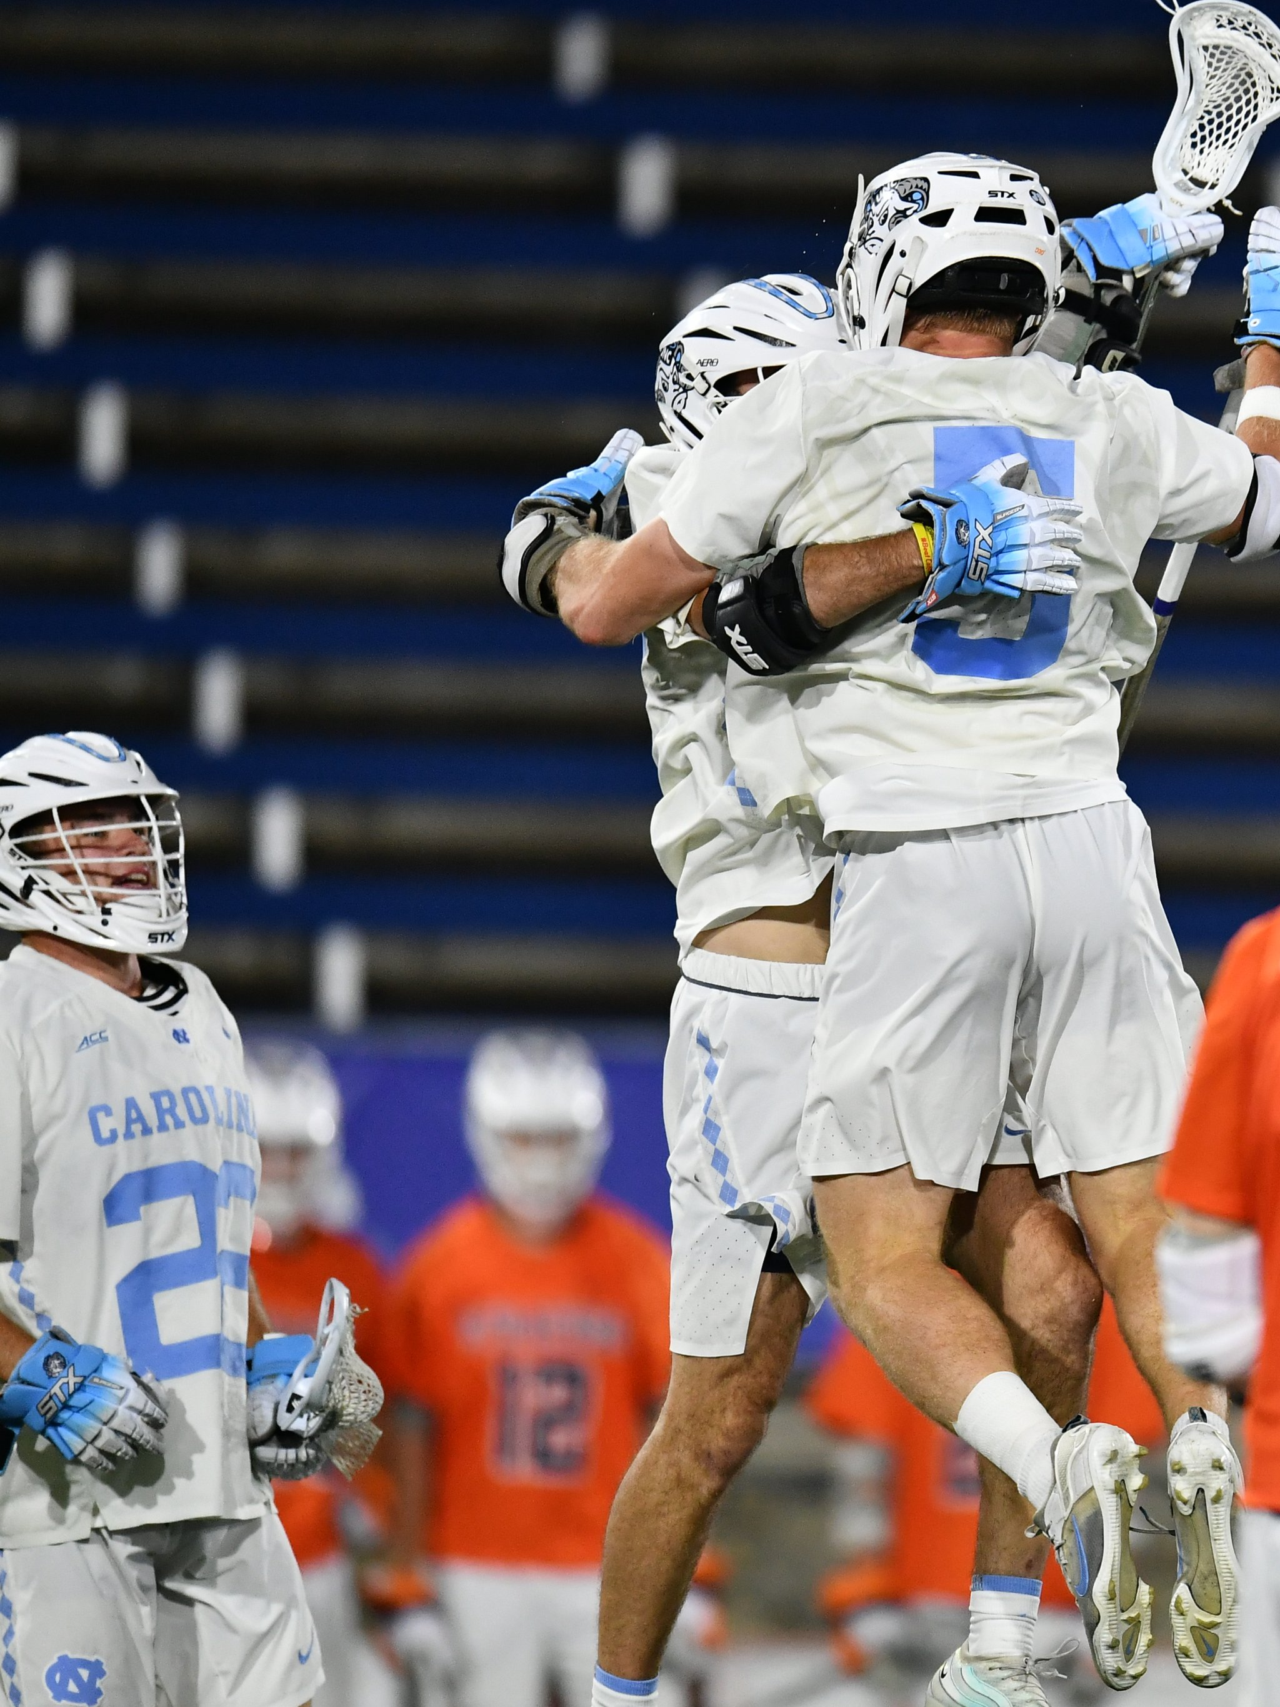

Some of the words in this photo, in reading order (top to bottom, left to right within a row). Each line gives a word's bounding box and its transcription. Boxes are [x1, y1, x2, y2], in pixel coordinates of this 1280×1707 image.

[987, 189, 1017, 199] STX
[695, 358, 719, 367] AERO
[967, 517, 995, 585] STX
[724, 623, 770, 671] STX
[148, 931, 176, 943] STX
[76, 1029, 109, 1053] ACC
[87, 1085, 258, 1147] CAROLIN
[36, 1362, 87, 1425] STX
